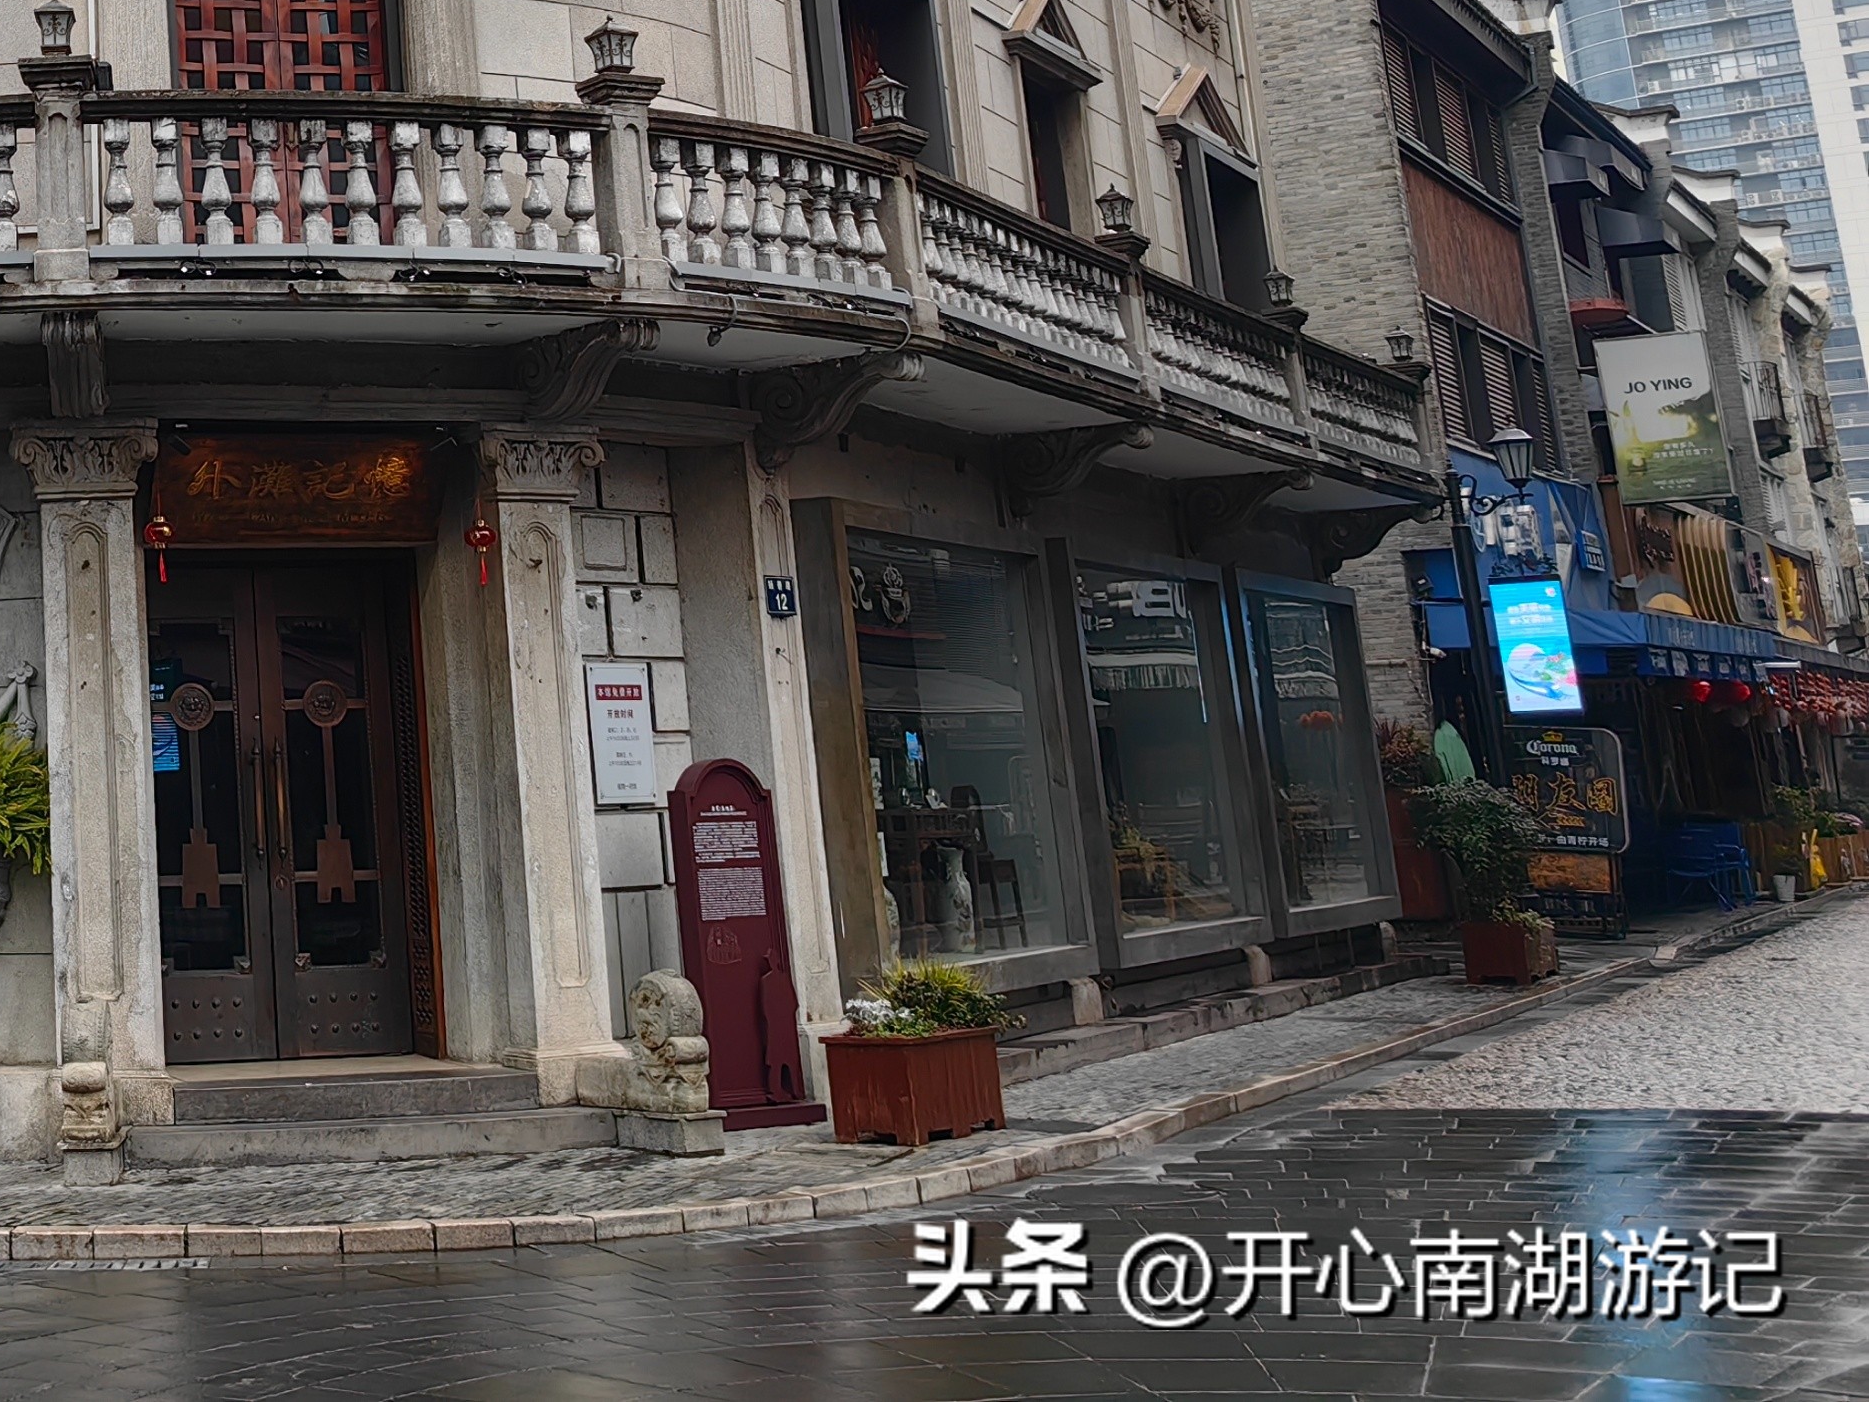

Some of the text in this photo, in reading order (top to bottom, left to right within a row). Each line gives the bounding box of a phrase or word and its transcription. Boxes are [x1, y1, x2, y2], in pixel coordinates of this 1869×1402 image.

[1624, 377, 1693, 394] JO YING
[775, 593, 789, 611] 12
[1526, 739, 1579, 755] Corona
